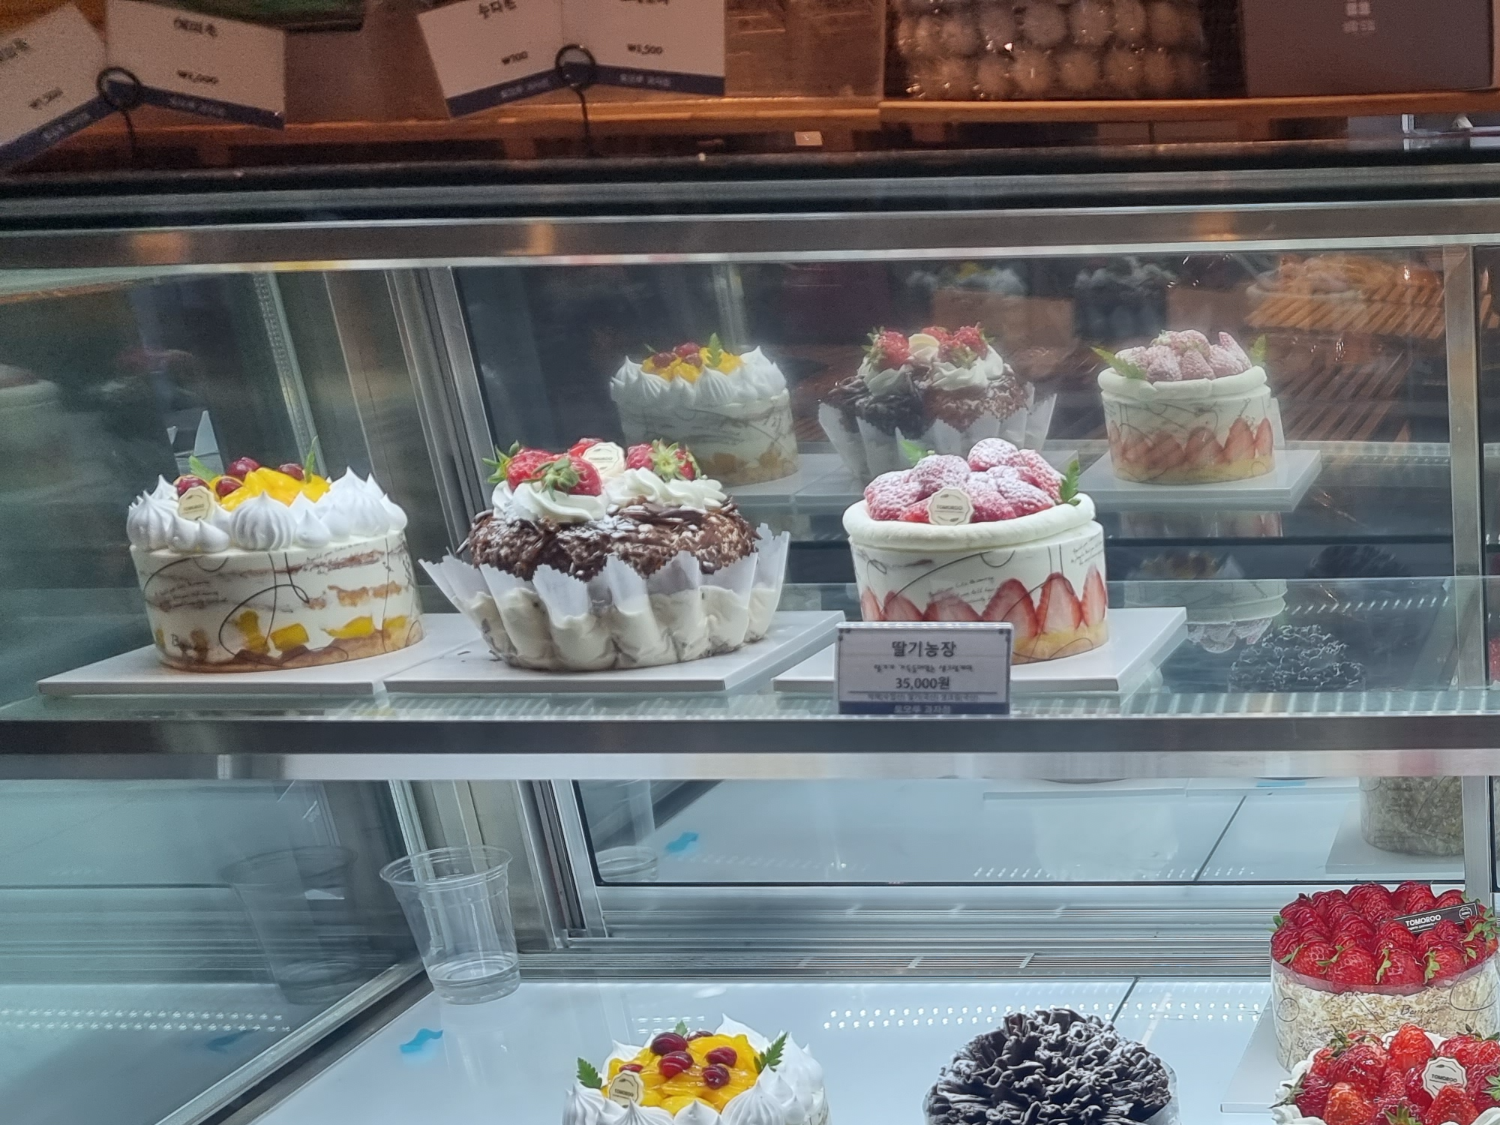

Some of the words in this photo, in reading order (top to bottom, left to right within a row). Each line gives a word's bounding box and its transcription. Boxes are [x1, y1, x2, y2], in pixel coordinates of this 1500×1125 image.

[891, 640, 957, 658] 딸기농장
[895, 676, 950, 690] 35,000원
[1405, 914, 1442, 927] TOMOROO
